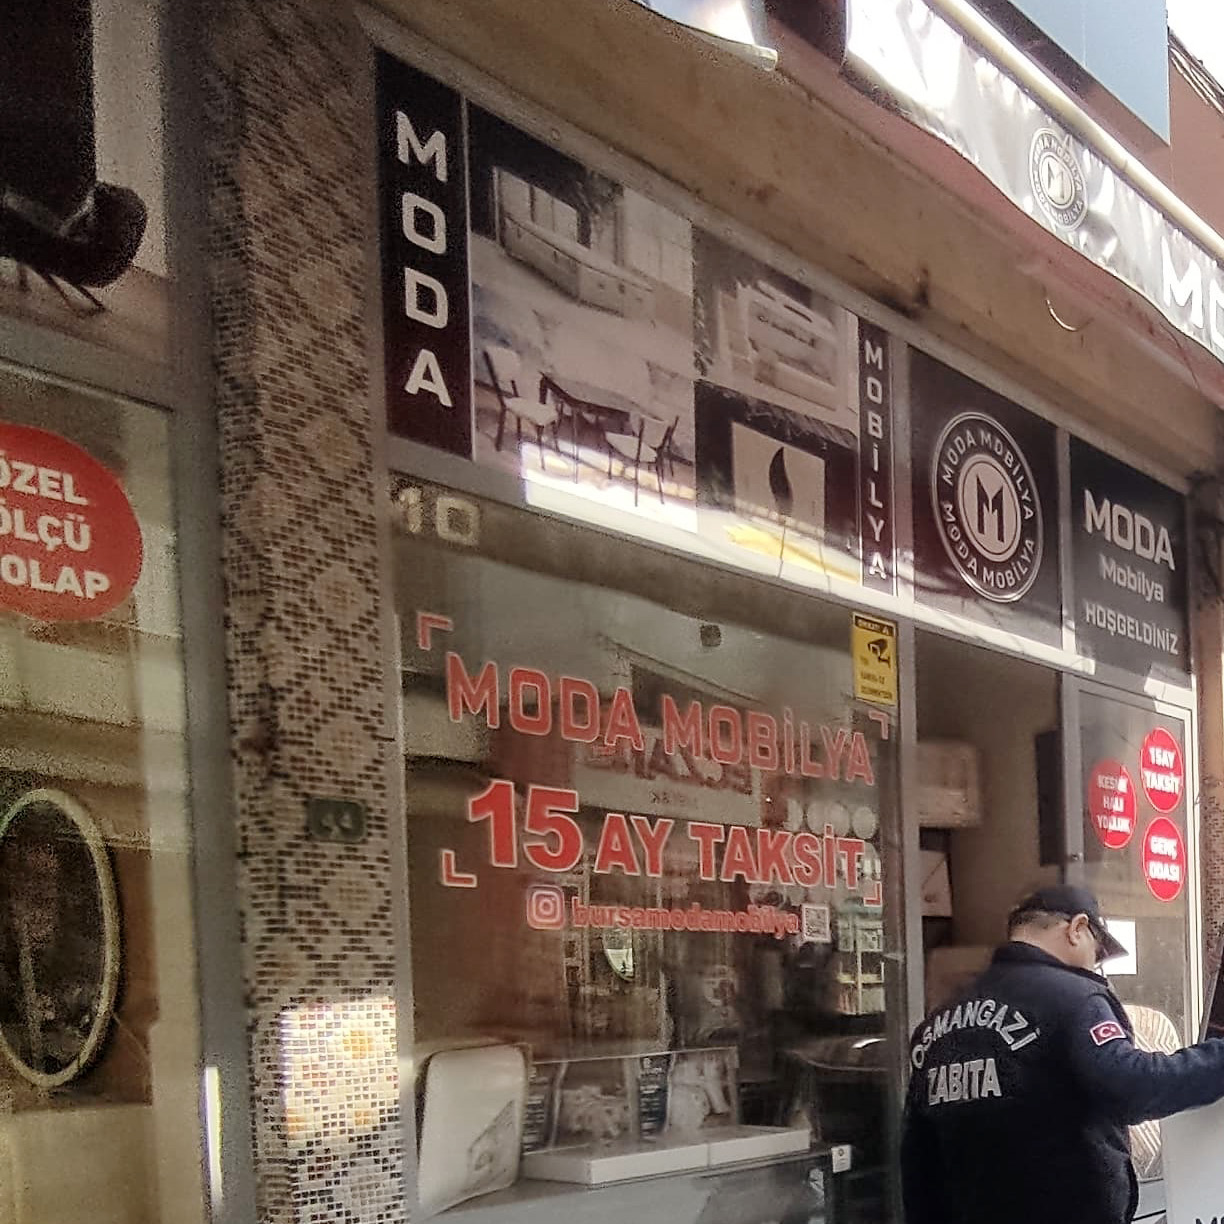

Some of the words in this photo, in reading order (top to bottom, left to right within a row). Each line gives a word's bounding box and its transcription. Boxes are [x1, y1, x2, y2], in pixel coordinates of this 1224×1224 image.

[396, 111, 452, 407] MODA
[865, 340, 886, 579] MOBİLYA
[942, 429, 977, 486] MODA
[941, 502, 978, 575] MODA
[1084, 489, 1175, 571] MODA
[1100, 554, 1164, 603] Mobilya
[1085, 601, 1179, 656] HOŞGELDİNİZ
[446, 651, 644, 751] MODA
[663, 694, 875, 787] MOBİLYA
[468, 779, 584, 872] 15
[594, 812, 675, 878] AY
[688, 821, 866, 890] TAKSİT
[912, 999, 1041, 1069] OSMANGAZİ
[928, 1058, 1002, 1106] ZABITA
